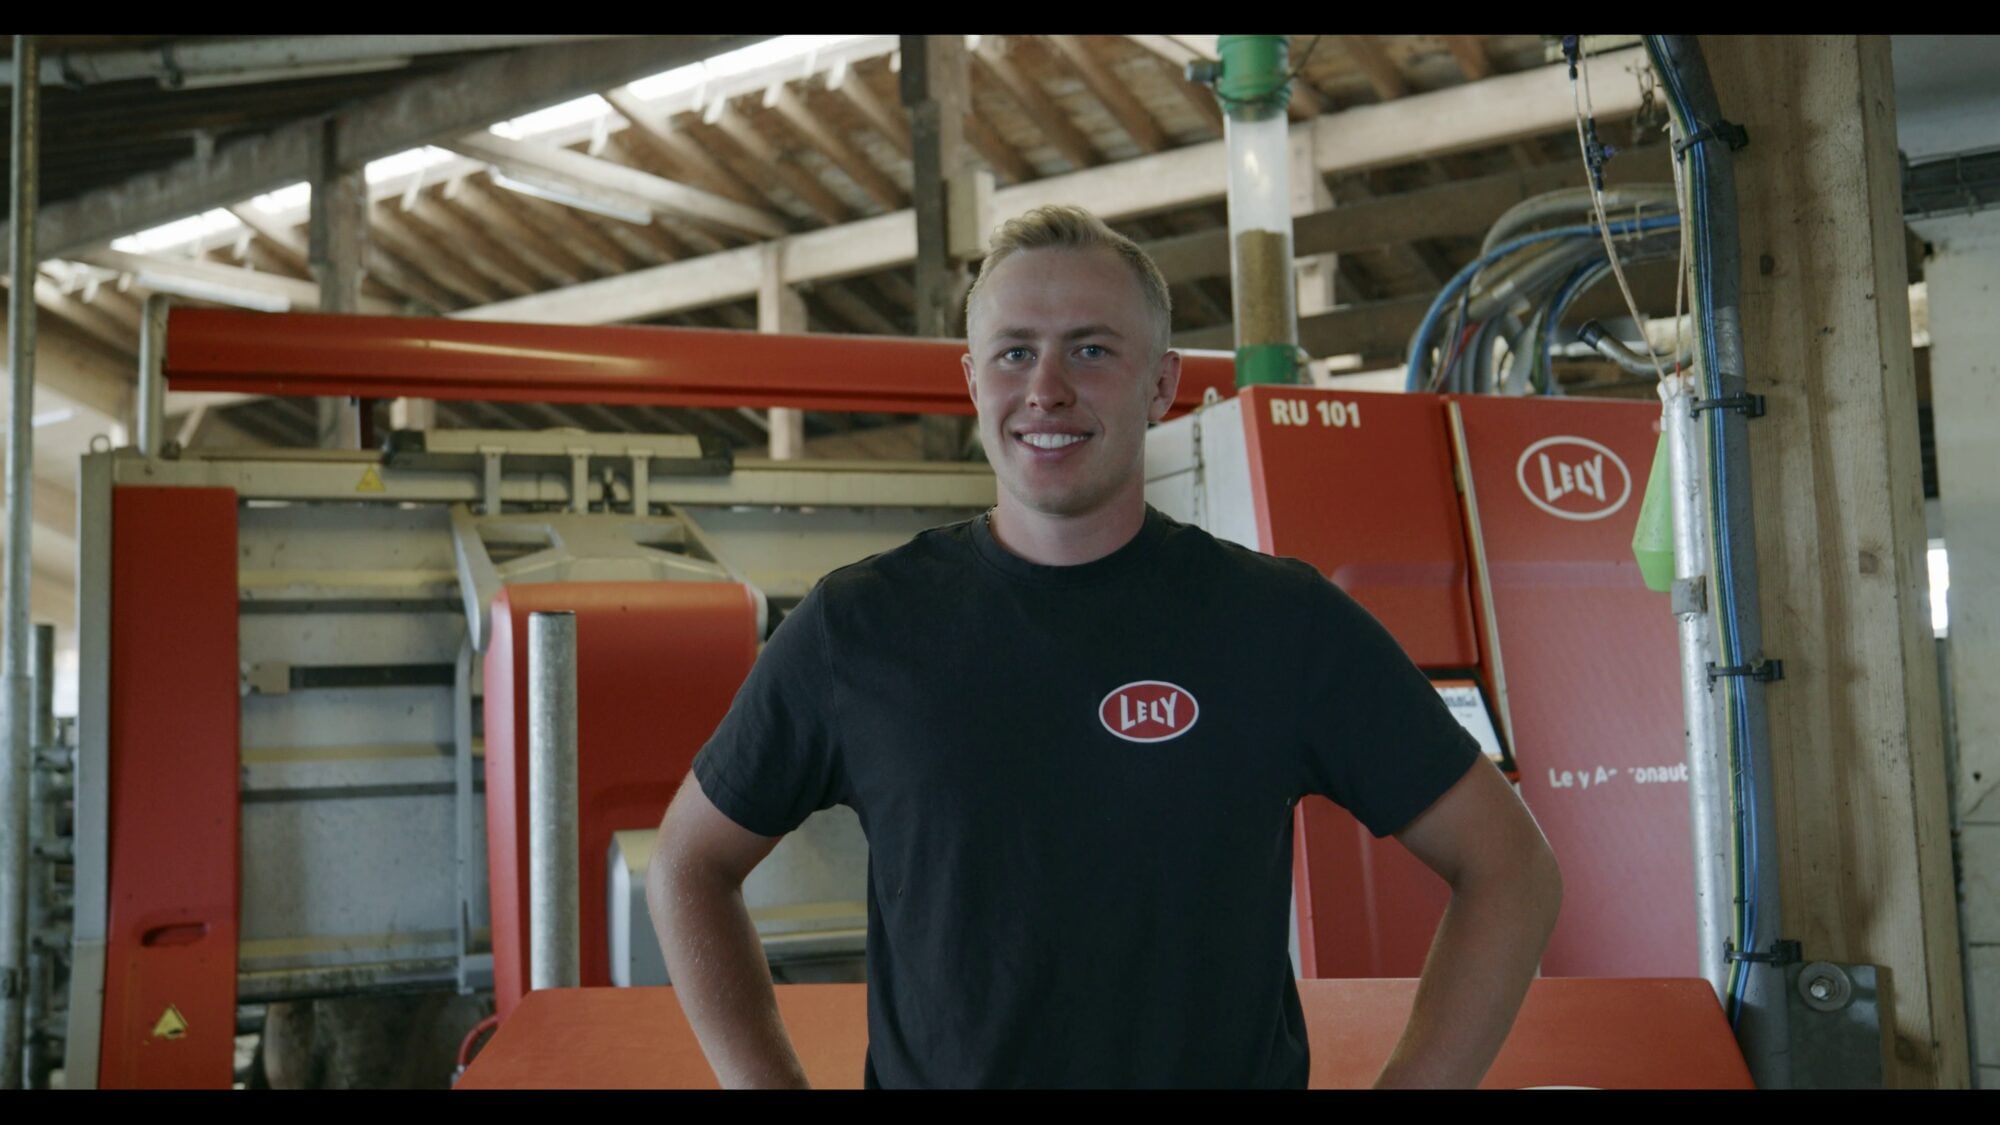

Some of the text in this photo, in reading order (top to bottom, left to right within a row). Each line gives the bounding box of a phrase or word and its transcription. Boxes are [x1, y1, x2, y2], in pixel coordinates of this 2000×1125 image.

[1270, 399, 1361, 428] RU 101
[1540, 453, 1606, 502] LELY
[1120, 691, 1178, 731] LELY
[1549, 768, 1590, 789] Ley
